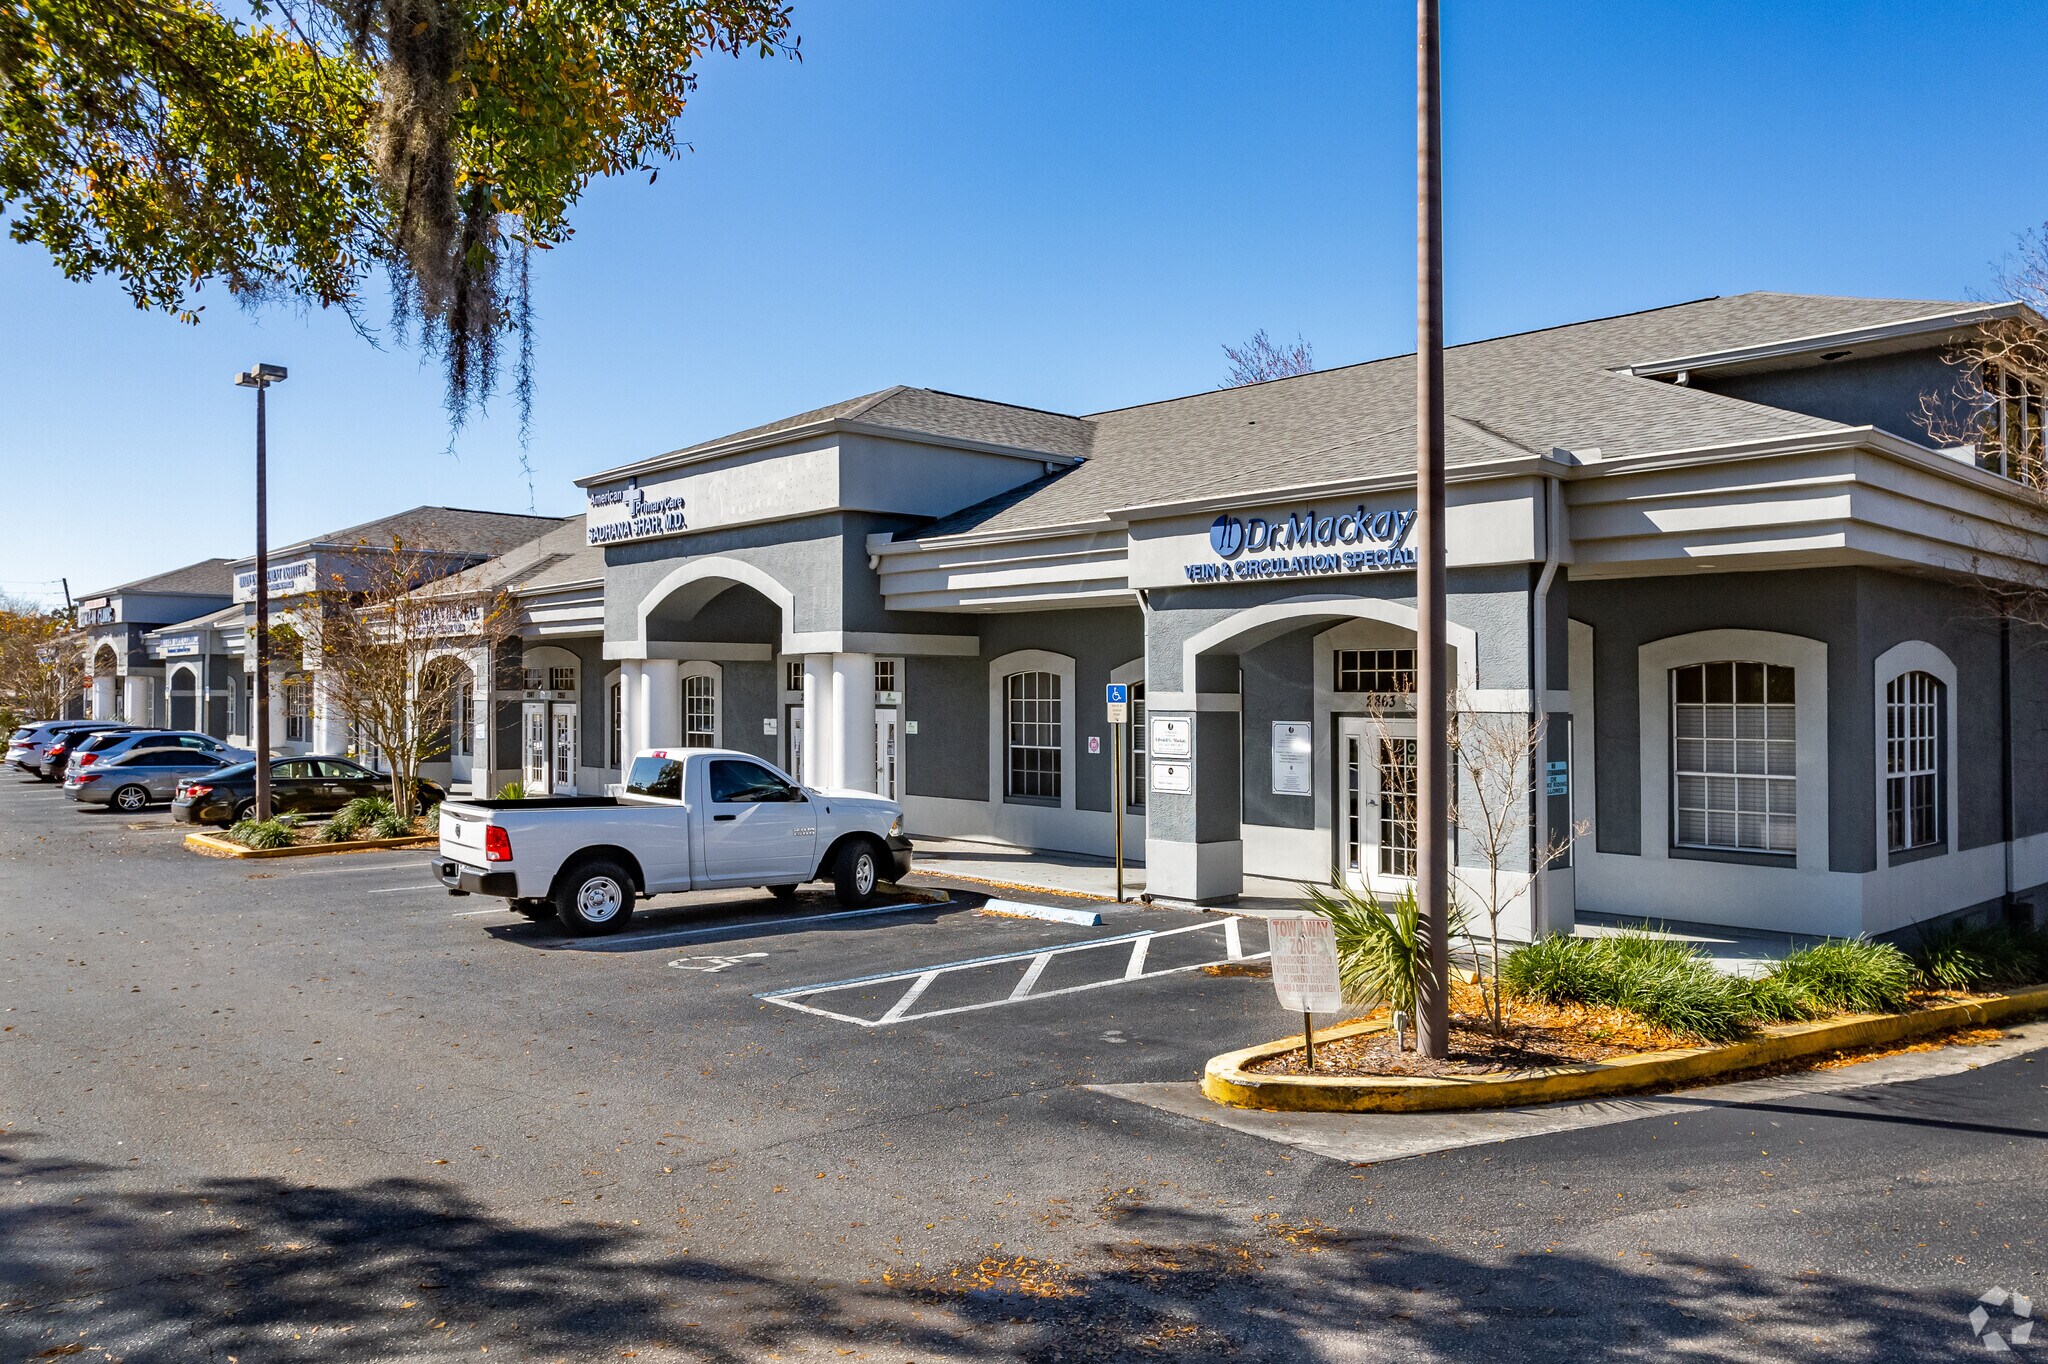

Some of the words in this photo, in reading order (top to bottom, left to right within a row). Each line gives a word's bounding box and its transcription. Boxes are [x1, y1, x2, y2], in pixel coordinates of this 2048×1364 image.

[591, 490, 622, 505] American
[589, 521, 632, 542] SADHANA
[634, 515, 663, 538] SHAH,
[665, 512, 686, 532] M.D.
[1184, 563, 1216, 581] VEIN
[1220, 562, 1230, 577] &
[1234, 553, 1338, 577] CIRCULATION
[1343, 547, 1418, 569] SPECIALI
[1366, 695, 1396, 707] 2863
[1272, 920, 1296, 938] TOW
[1299, 921, 1328, 938] AWAY
[1290, 938, 1317, 955] ZONE
[1290, 975, 1308, 983] OWNERS
